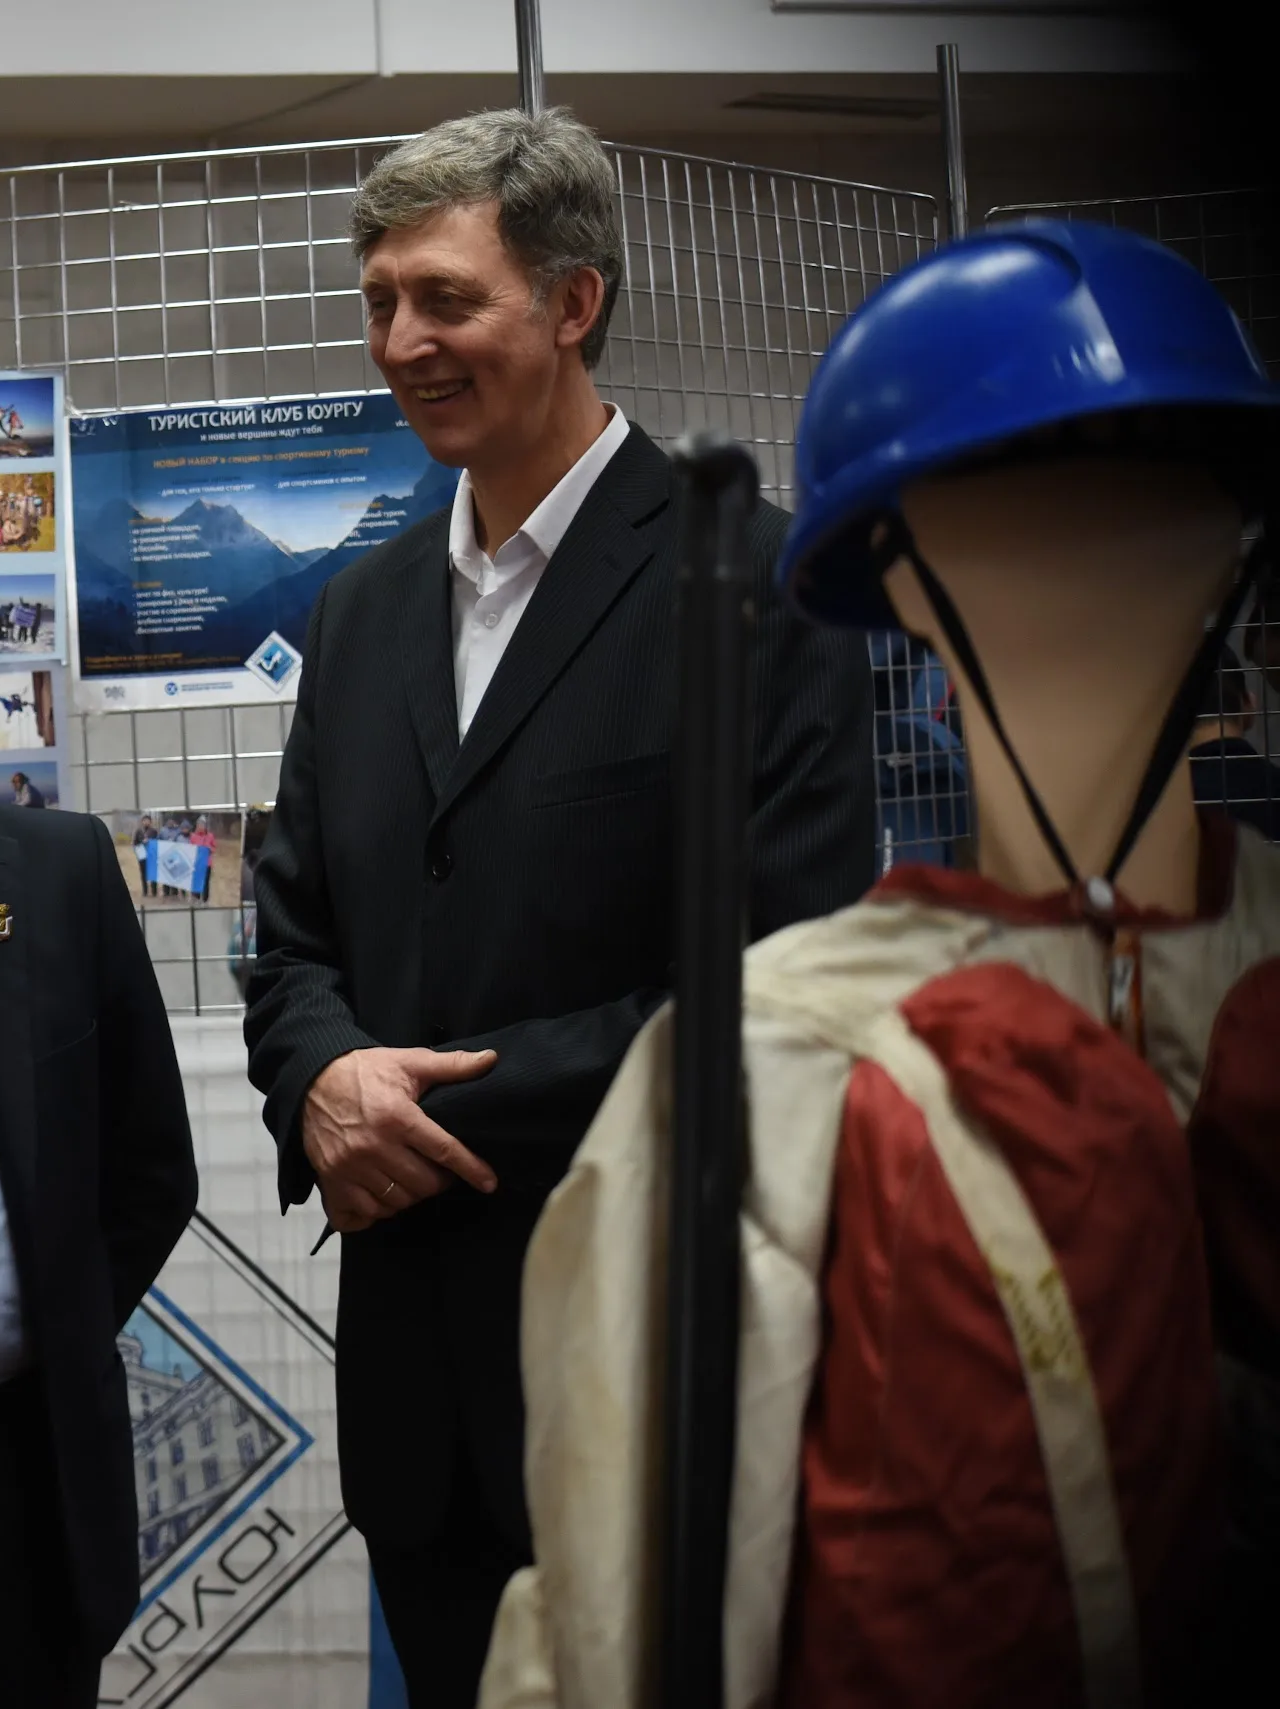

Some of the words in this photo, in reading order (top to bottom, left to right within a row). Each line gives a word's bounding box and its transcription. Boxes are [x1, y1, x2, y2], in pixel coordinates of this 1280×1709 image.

[148, 406, 257, 431] ТУРИСТСКИЙ
[261, 404, 303, 425] КЛУБ
[307, 401, 364, 421] ЮУРГУ
[200, 434, 207, 442] и
[208, 433, 236, 441] новые
[237, 429, 277, 441] вершины
[278, 428, 301, 438] ждут
[302, 424, 323, 434] тебя
[153, 457, 186, 468] НОВЫЙ
[188, 456, 218, 466] НАБОР
[274, 449, 331, 462] спортивному
[333, 447, 369, 458] туризму
[97, 1506, 296, 1709] ЮУрГ
